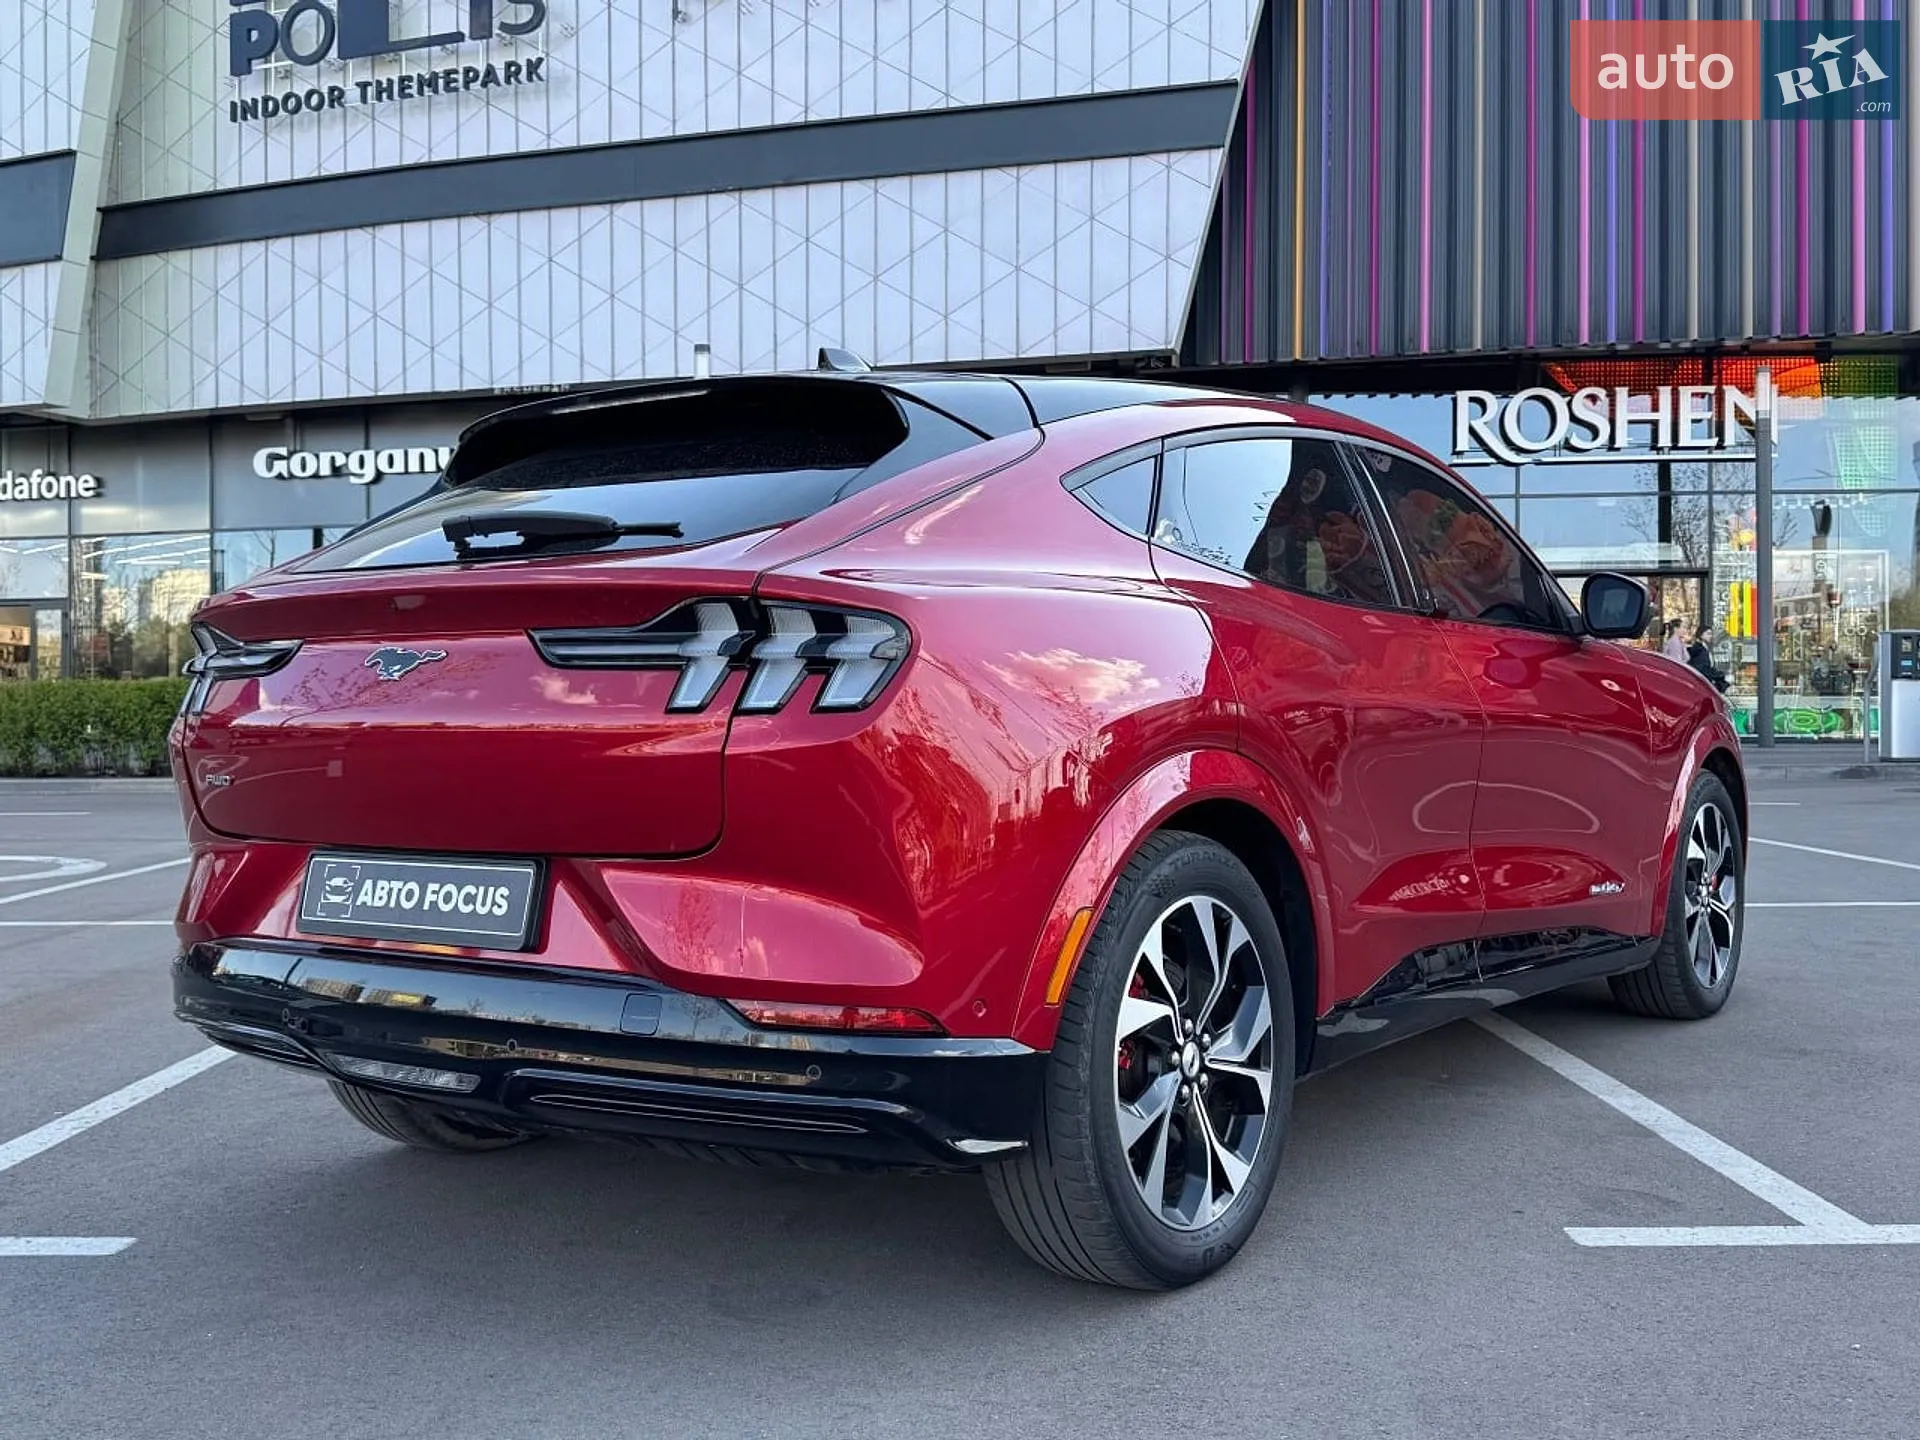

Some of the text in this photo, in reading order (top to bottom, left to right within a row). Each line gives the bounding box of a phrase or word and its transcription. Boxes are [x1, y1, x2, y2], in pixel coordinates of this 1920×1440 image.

[229, 57, 546, 123] INDOOR THEMEPARK
[1454, 386, 1778, 465] ROSHEN
[0, 468, 97, 500] dafone
[423, 882, 510, 916] FOCUS
